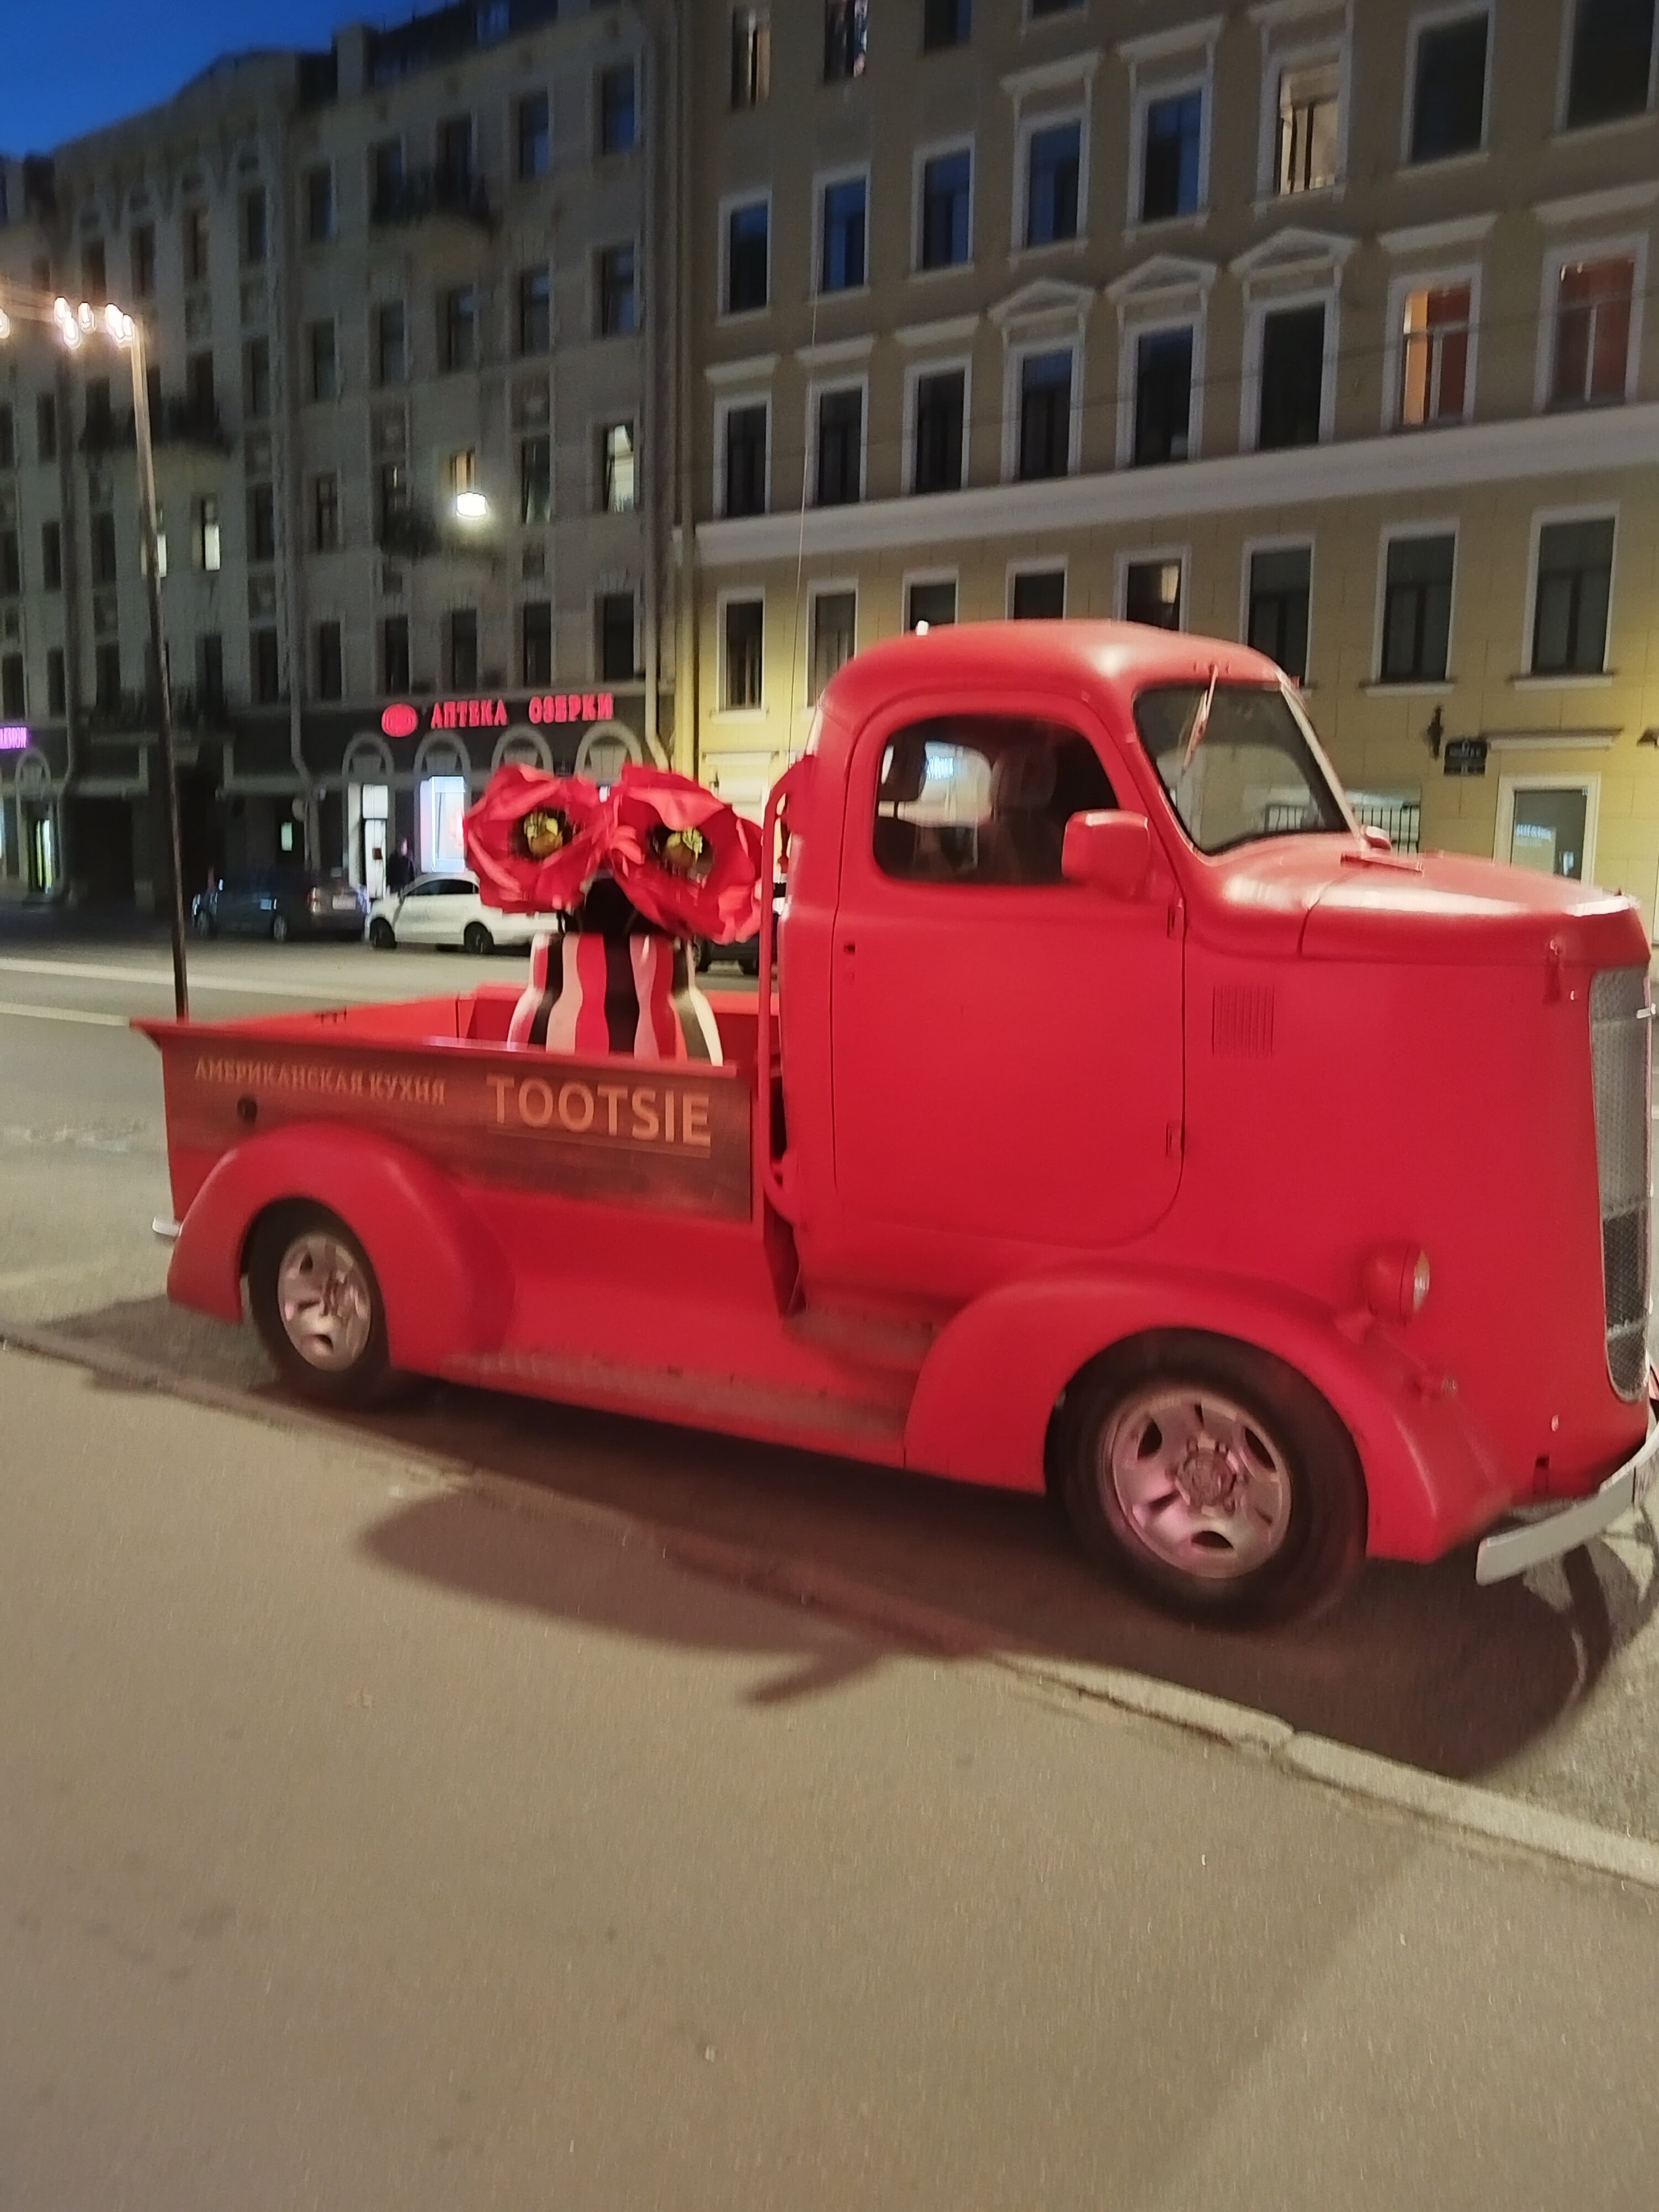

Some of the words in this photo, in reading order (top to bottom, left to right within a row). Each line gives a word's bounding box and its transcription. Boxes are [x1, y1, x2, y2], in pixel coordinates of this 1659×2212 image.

[430, 698, 508, 729] АПТЕКА
[529, 692, 613, 724] ОЗЕРКИ
[369, 1070, 445, 1105] КУХНЯ
[486, 1072, 711, 1147] TOOTSIE
